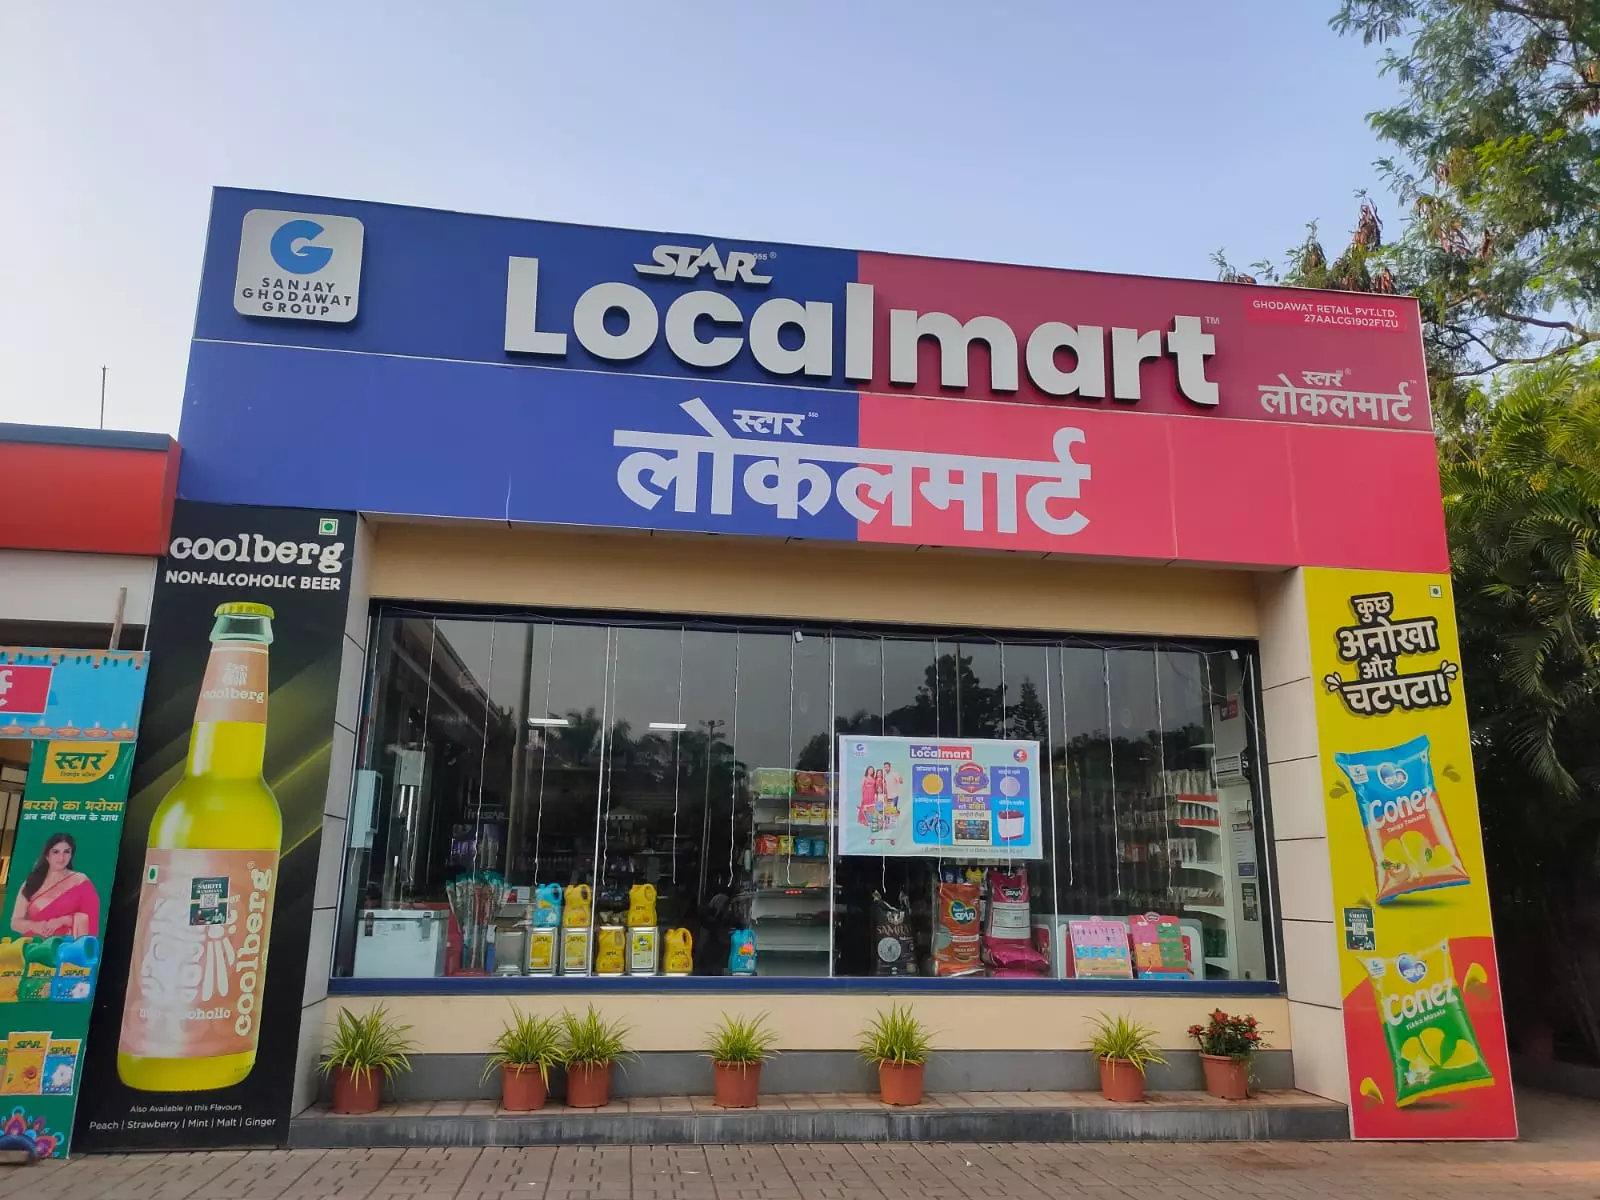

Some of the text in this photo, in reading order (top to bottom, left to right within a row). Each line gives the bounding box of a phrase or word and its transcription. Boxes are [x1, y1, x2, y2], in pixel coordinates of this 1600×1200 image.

[633, 242, 773, 285] STAR
[261, 277, 336, 294] SANJAY
[242, 287, 352, 307] GHODAWAT
[1252, 300, 1314, 312] GHODAWAT
[1316, 305, 1353, 315] RETAIL
[262, 301, 330, 316] GROUP
[1302, 370, 1344, 387] स्टार
[1258, 373, 1413, 422] लोकलमार्ट
[732, 409, 806, 437] स्टार
[613, 397, 1091, 536] लोकलमार्ट
[170, 533, 345, 574] coolberg
[165, 570, 341, 591] NON-ALCOHOLIC BEER
[1354, 595, 1390, 623] कुछ
[1339, 616, 1437, 657] अनोखा
[1361, 653, 1394, 680] और
[54, 751, 108, 770] स्टार
[62, 801, 81, 811] का
[234, 868, 272, 1037] coolberg
[129, 1103, 242, 1113] Also Available in this Flavours
[88, 1117, 277, 1131] Peach Strawberry Mint Malt Ginger
